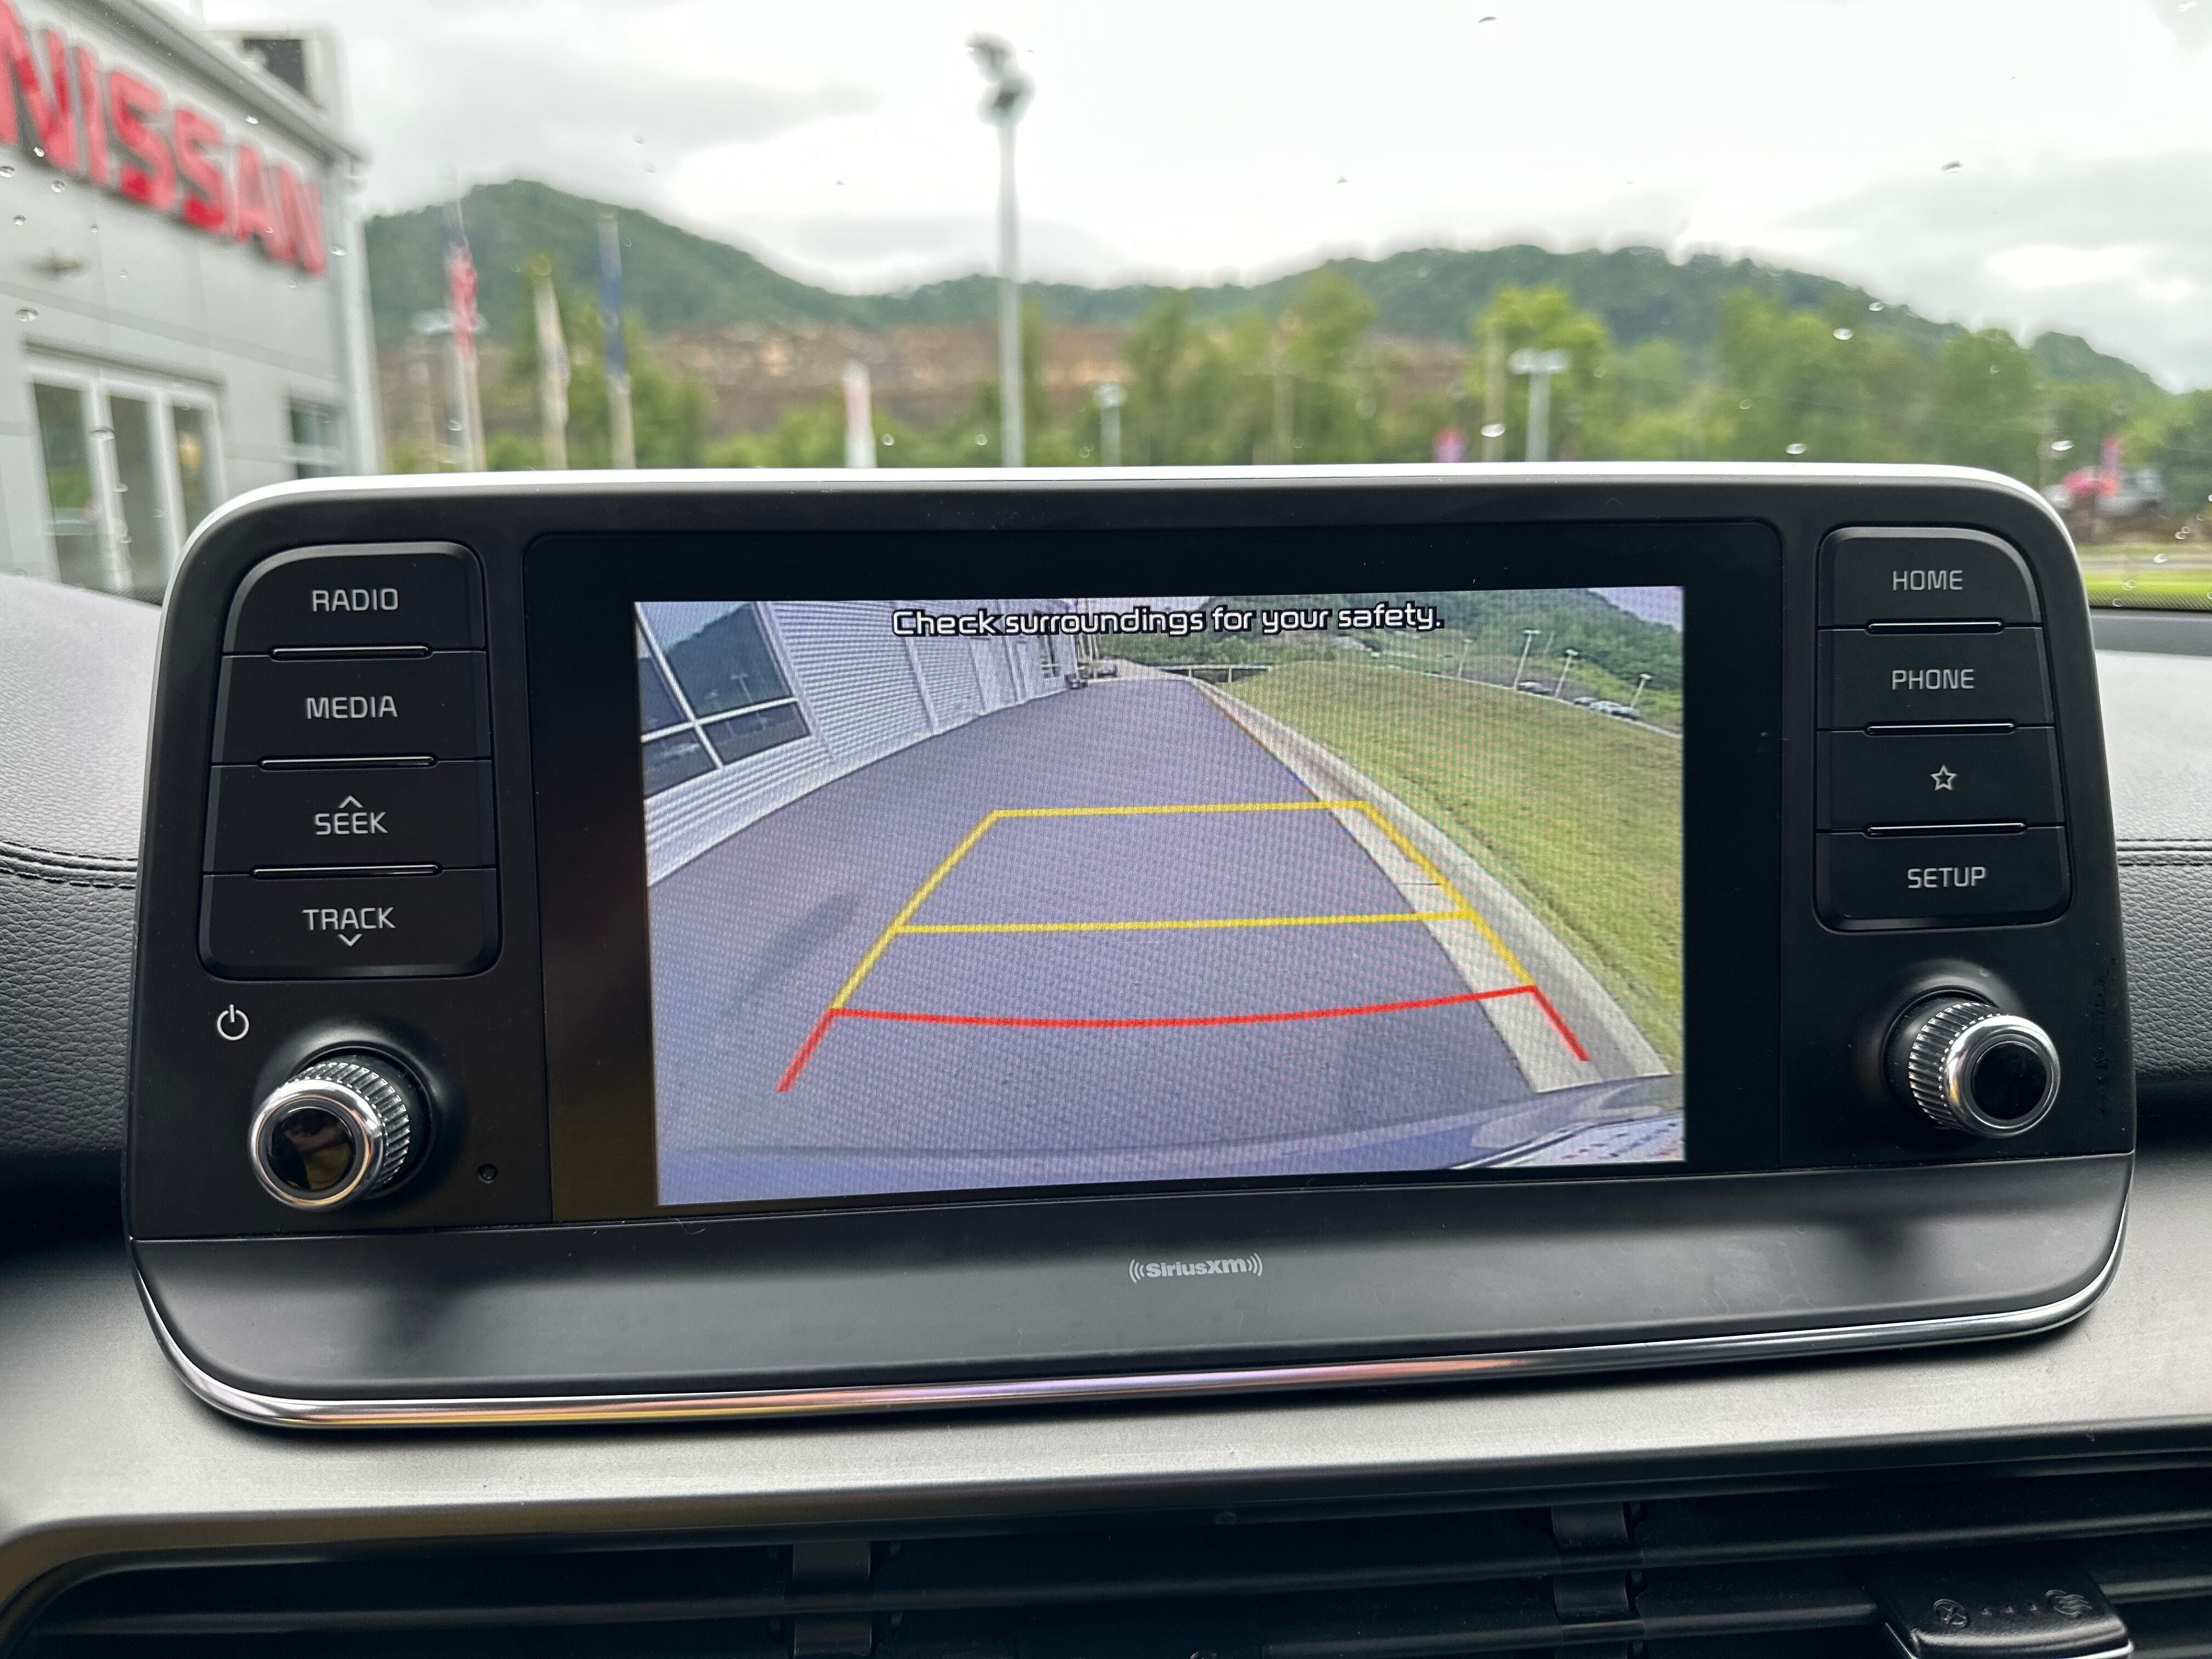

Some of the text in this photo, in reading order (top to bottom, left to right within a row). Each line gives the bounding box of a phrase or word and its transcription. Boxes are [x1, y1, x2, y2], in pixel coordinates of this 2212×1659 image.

[0, 0, 328, 275] NISSAN
[1892, 569, 1963, 591] HOME
[312, 588, 399, 612] RADIO
[893, 602, 1441, 635] Check surroundings for your safety.
[1891, 669, 1975, 690] PHONE
[306, 695, 398, 719] MEDIA
[314, 811, 389, 835] SEEK
[1907, 866, 1987, 889] SETUP
[302, 907, 396, 930] TRACK
